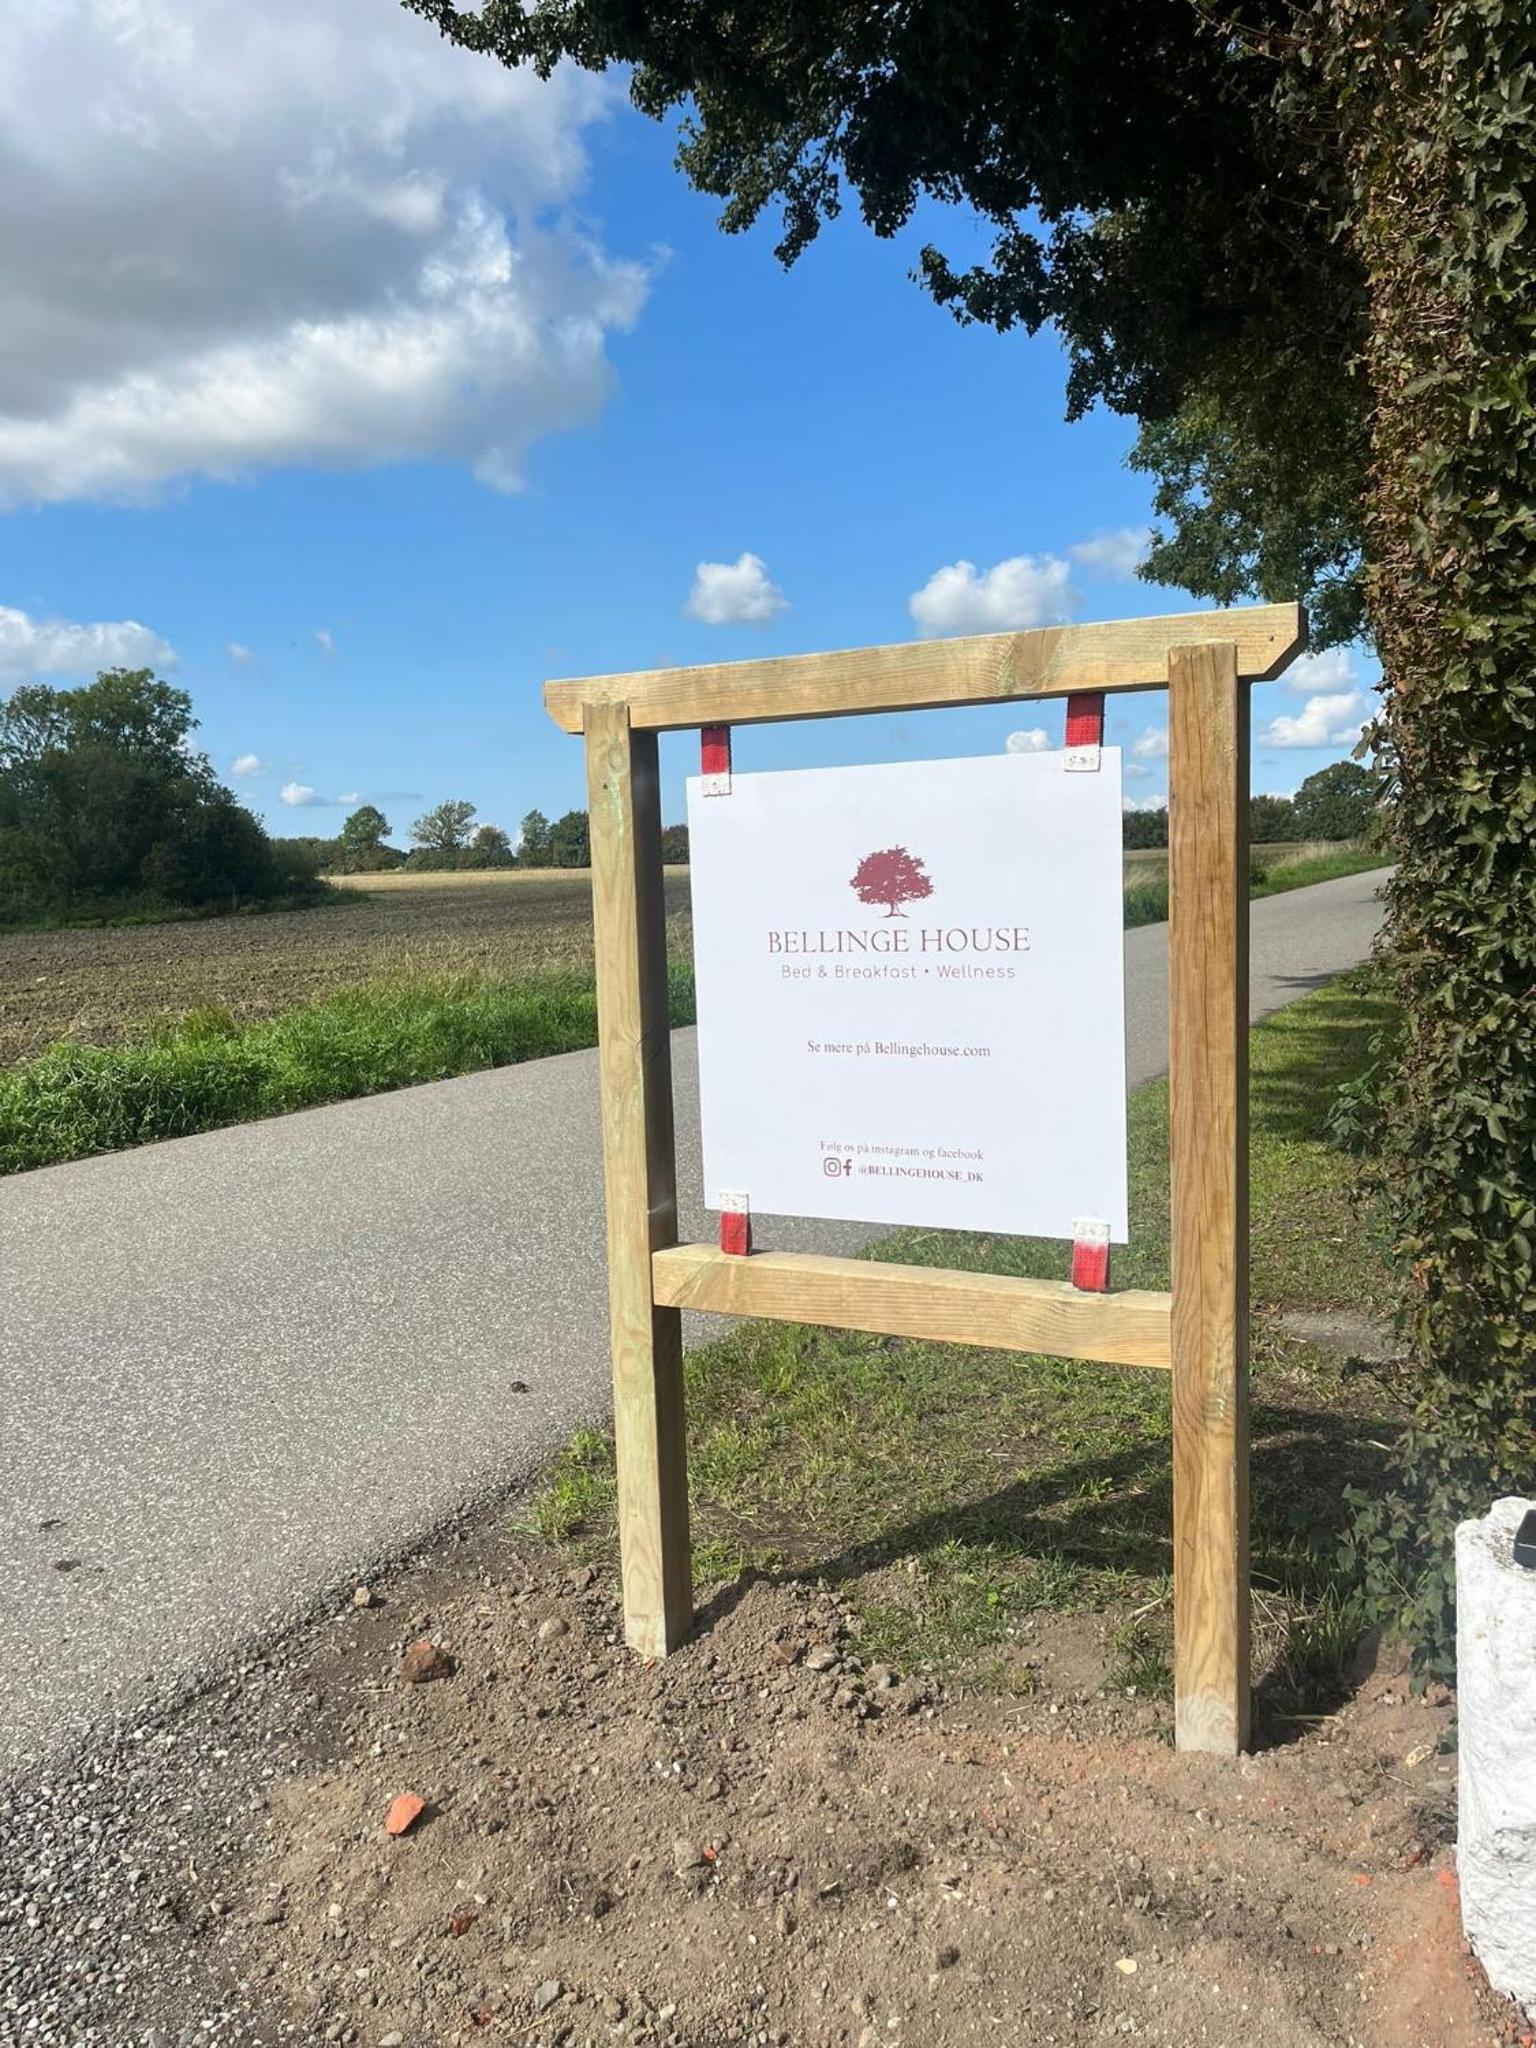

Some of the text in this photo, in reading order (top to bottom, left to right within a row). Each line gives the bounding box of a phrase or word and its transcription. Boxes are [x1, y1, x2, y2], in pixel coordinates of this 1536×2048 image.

[768, 927, 1031, 953] BELLINGE HOUSE
[781, 964, 1016, 979] Bed & Breakfast Wellness
[808, 1040, 991, 1058] Se mere på Bellingehouse.com
[844, 1143, 855, 1153] os
[857, 1143, 869, 1155] på
[871, 1144, 920, 1158] instagram
[922, 1148, 936, 1160] og
[937, 1146, 984, 1160] facebook
